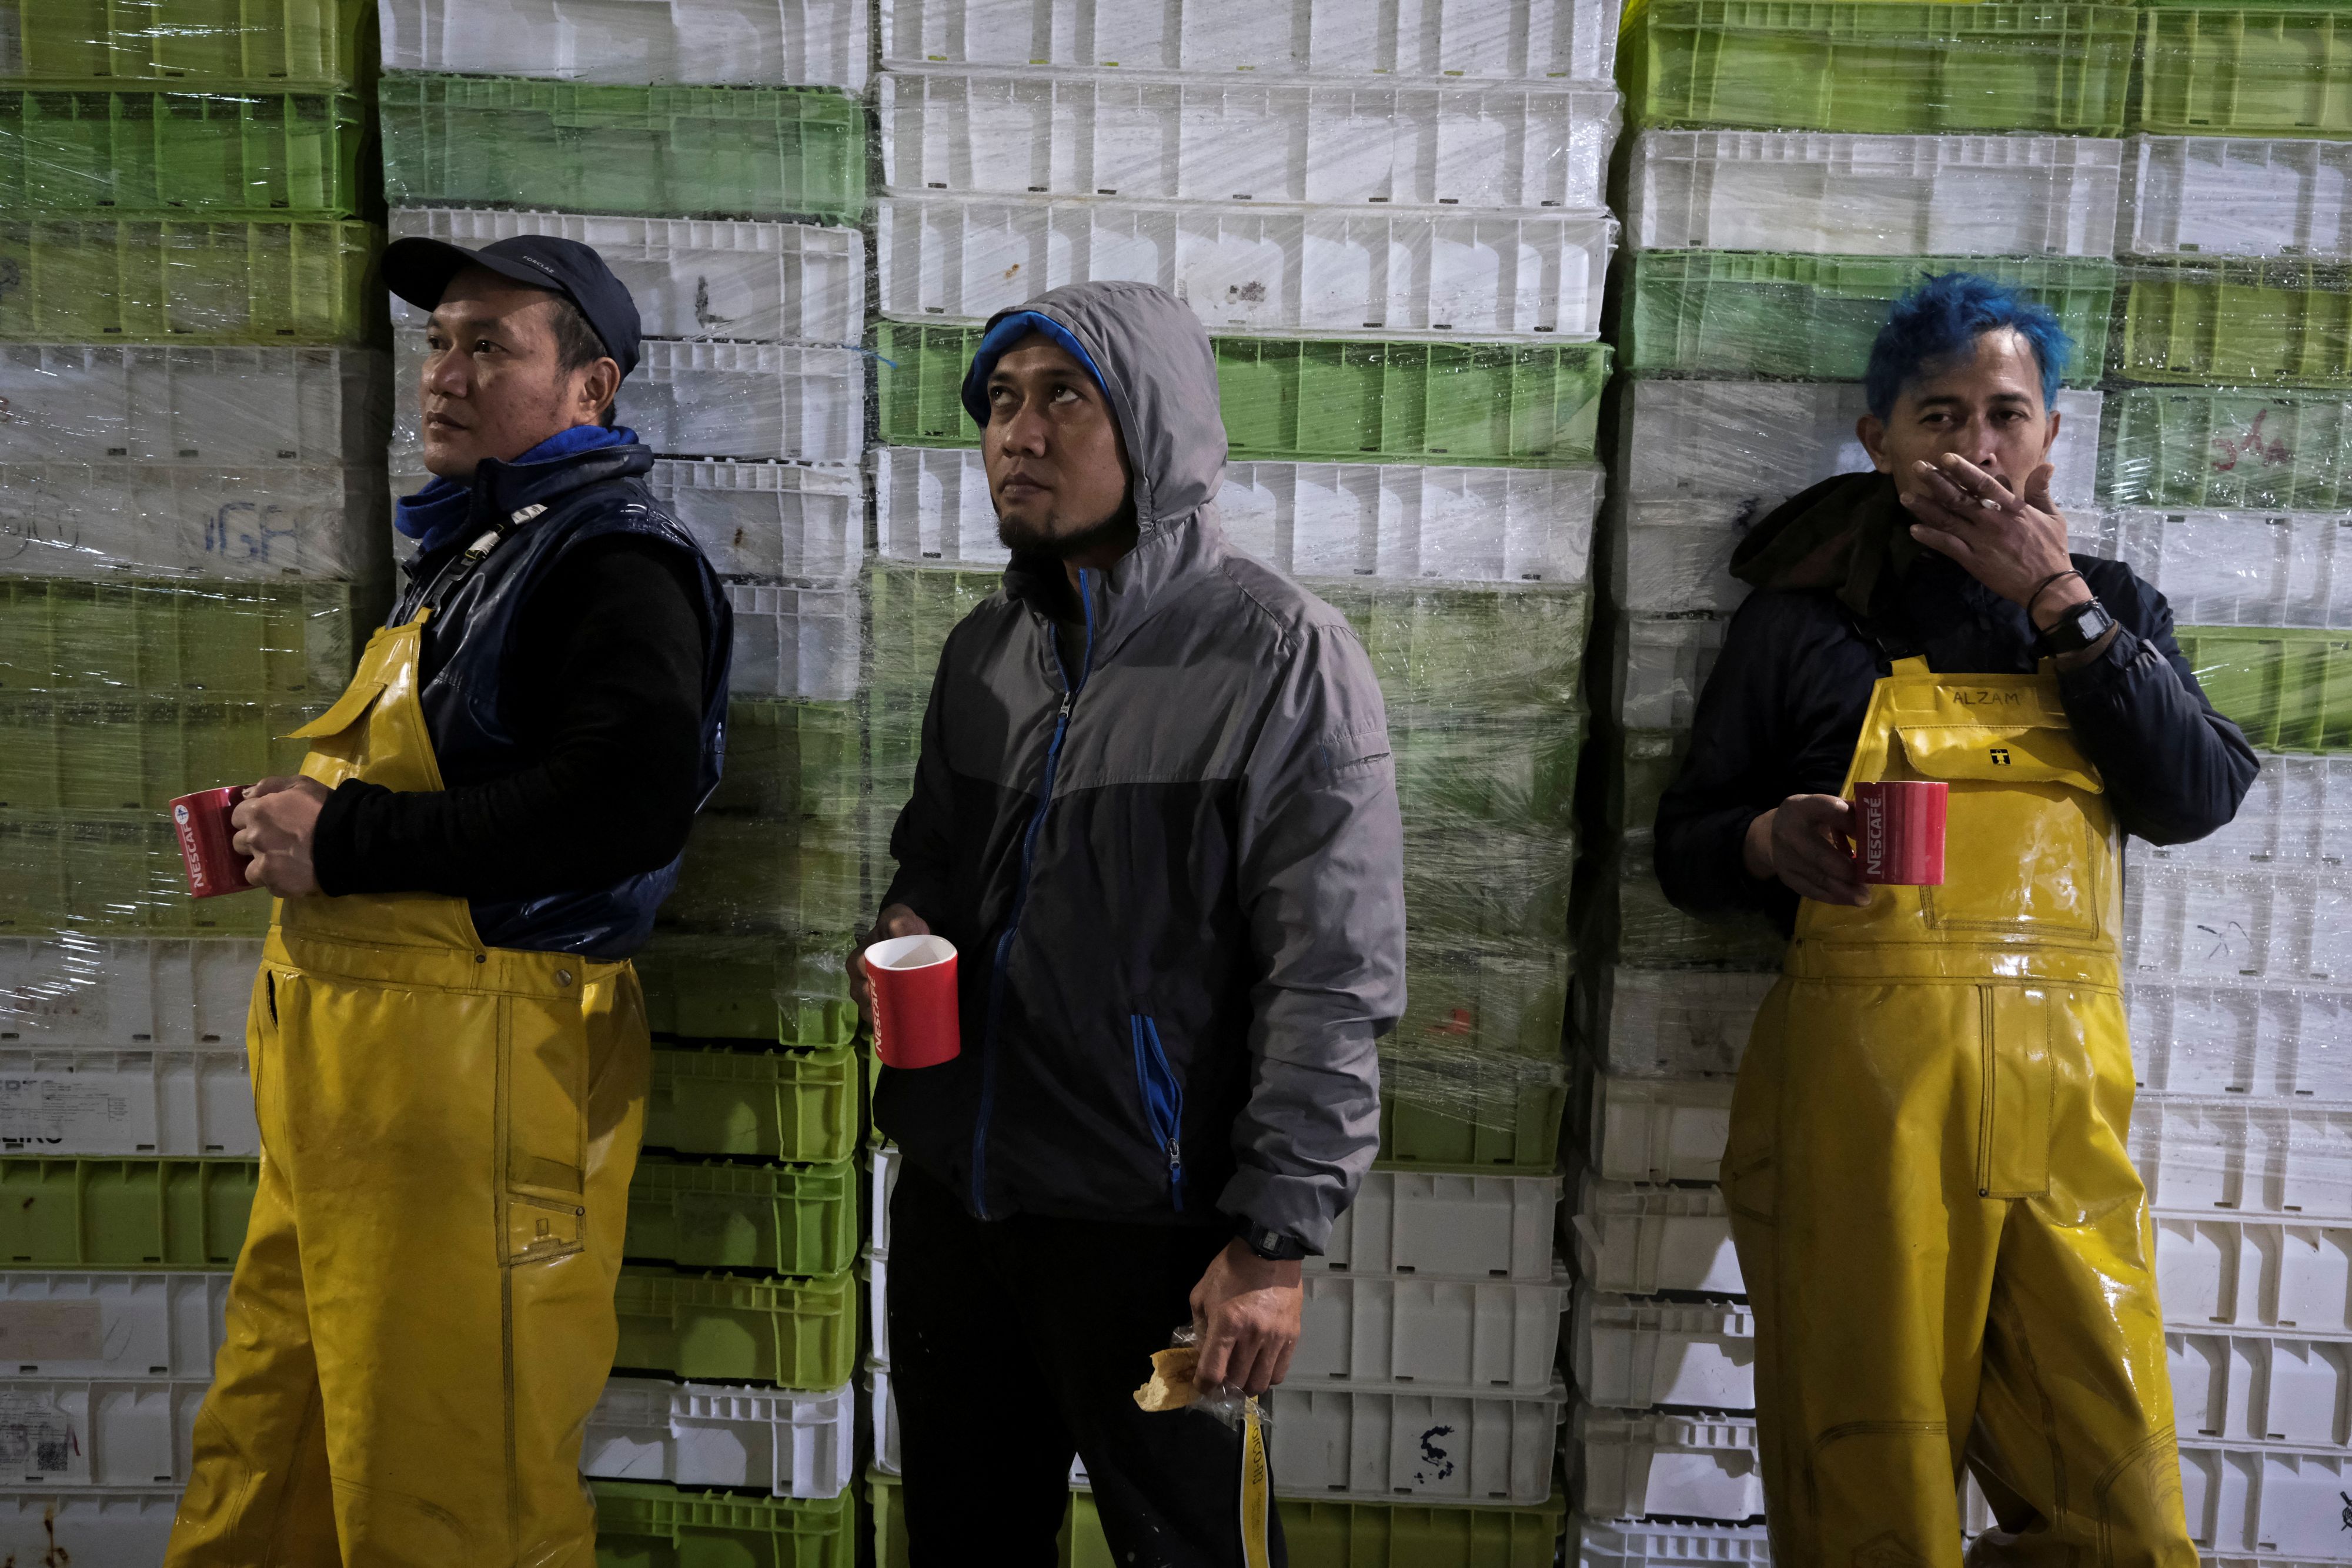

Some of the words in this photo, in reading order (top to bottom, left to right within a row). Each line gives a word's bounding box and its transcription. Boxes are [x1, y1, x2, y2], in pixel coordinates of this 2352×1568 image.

[523, 256, 554, 273] FORCLAZ
[1952, 691, 2021, 706] ALZAM
[179, 824, 205, 888] NESCAF
[1863, 797, 1882, 875] NESCAFÉ
[867, 973, 883, 1052] NESCAFÉ
